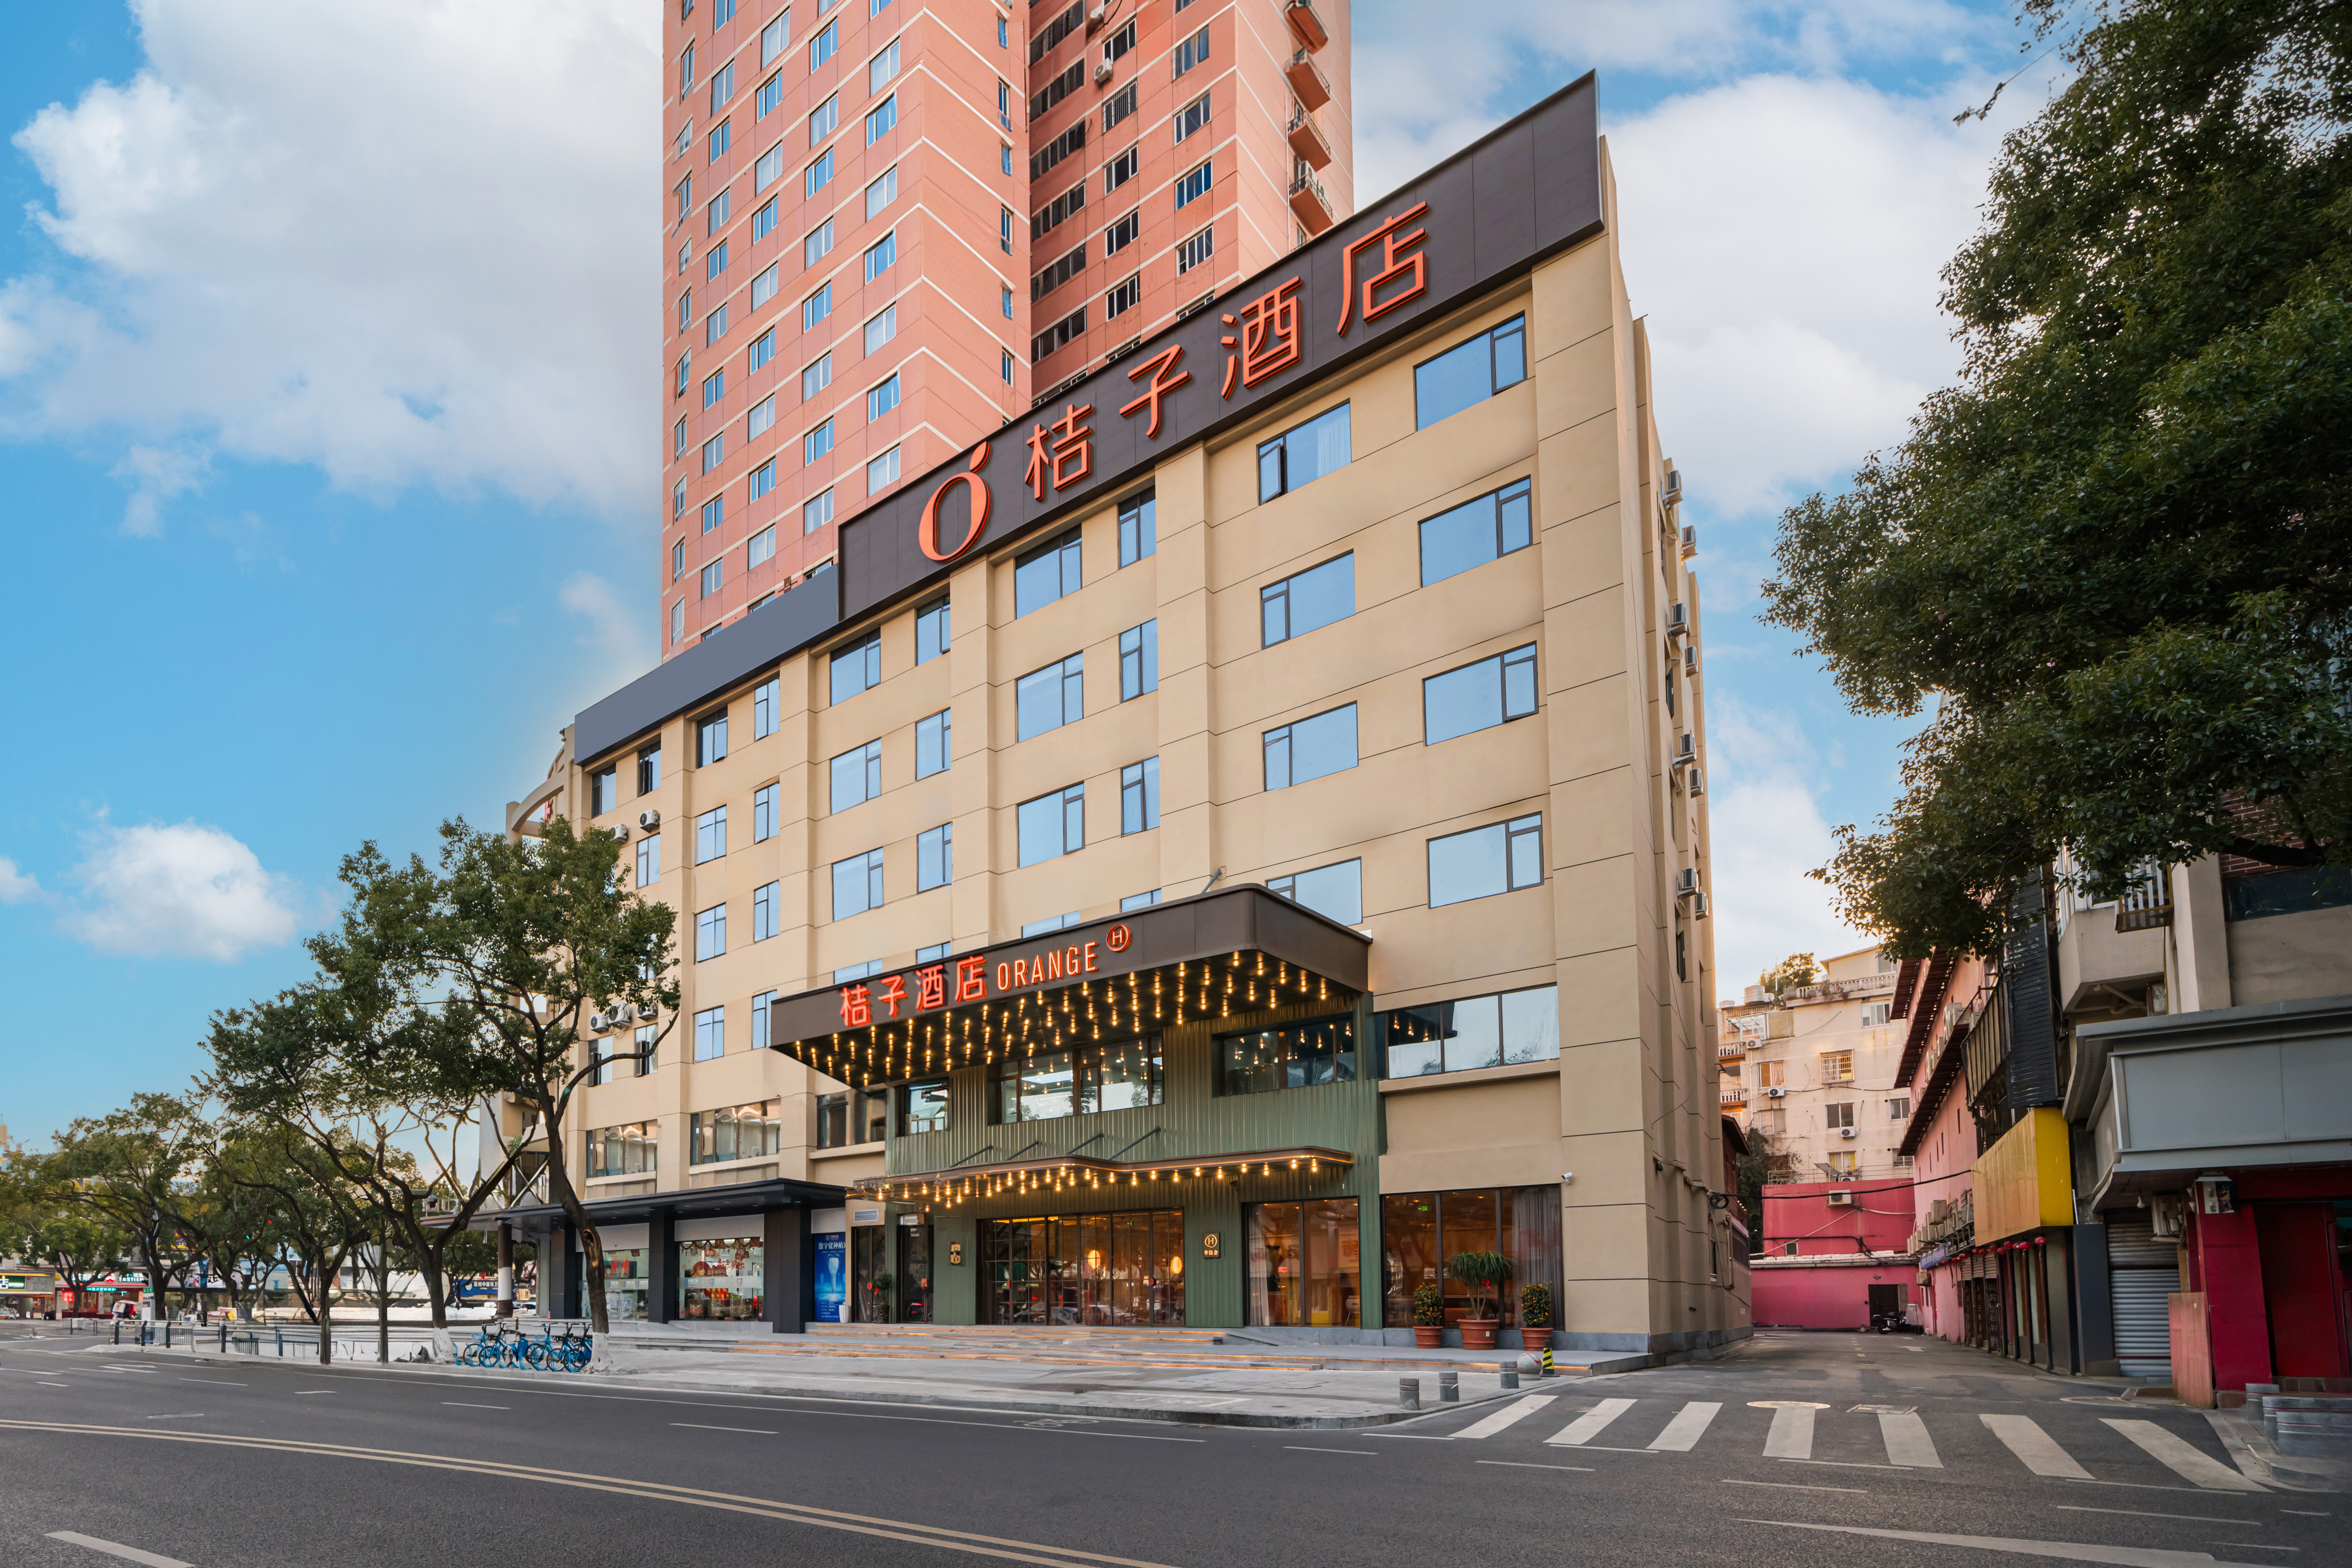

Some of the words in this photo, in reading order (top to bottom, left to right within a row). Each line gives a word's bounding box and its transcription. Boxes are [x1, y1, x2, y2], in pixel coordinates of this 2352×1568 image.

[1024, 201, 1429, 502] 桔子酒店
[840, 956, 988, 1028] 桔子酒店
[997, 941, 1098, 991] ORANGE
